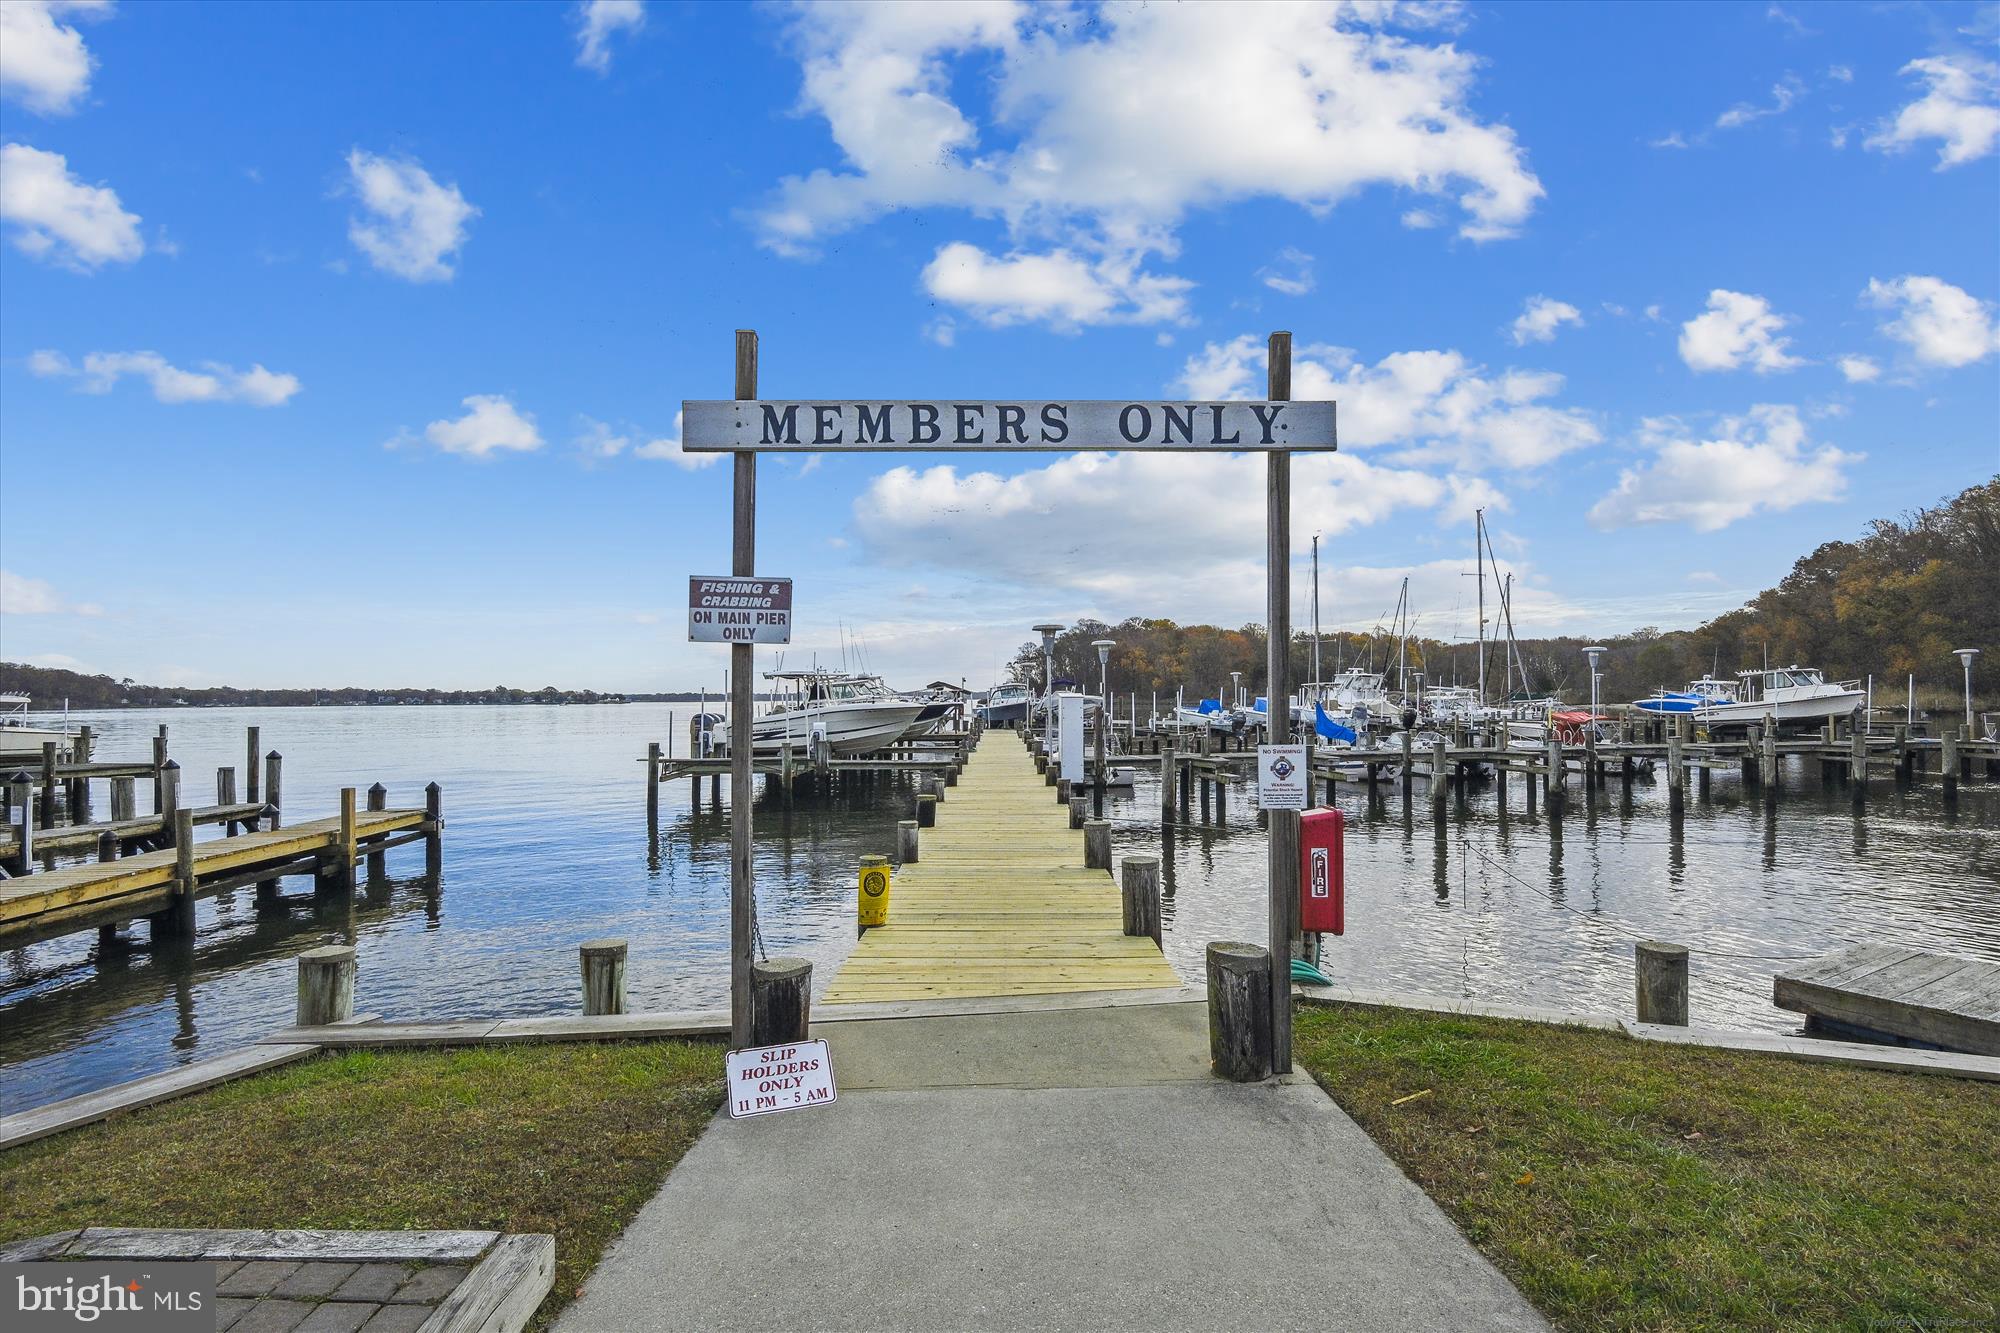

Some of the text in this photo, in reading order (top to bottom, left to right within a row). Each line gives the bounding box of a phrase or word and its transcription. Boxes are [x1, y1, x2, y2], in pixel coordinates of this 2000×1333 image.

[759, 403, 1286, 445] MEMBERS ONLY
[700, 582, 780, 595] FISHING &
[701, 595, 772, 608] CRABBING
[693, 611, 786, 625] ON MAIN PIER
[722, 627, 757, 640] ONLY
[1315, 860, 1325, 894] FIRE
[760, 1048, 797, 1064] SLIP
[741, 1059, 819, 1081] HOLDERS
[758, 1075, 805, 1093] ONLY
[738, 1099, 750, 1112] 11
[756, 1095, 777, 1109] PM
[794, 1091, 802, 1103] 5
[806, 1087, 829, 1102] AM
